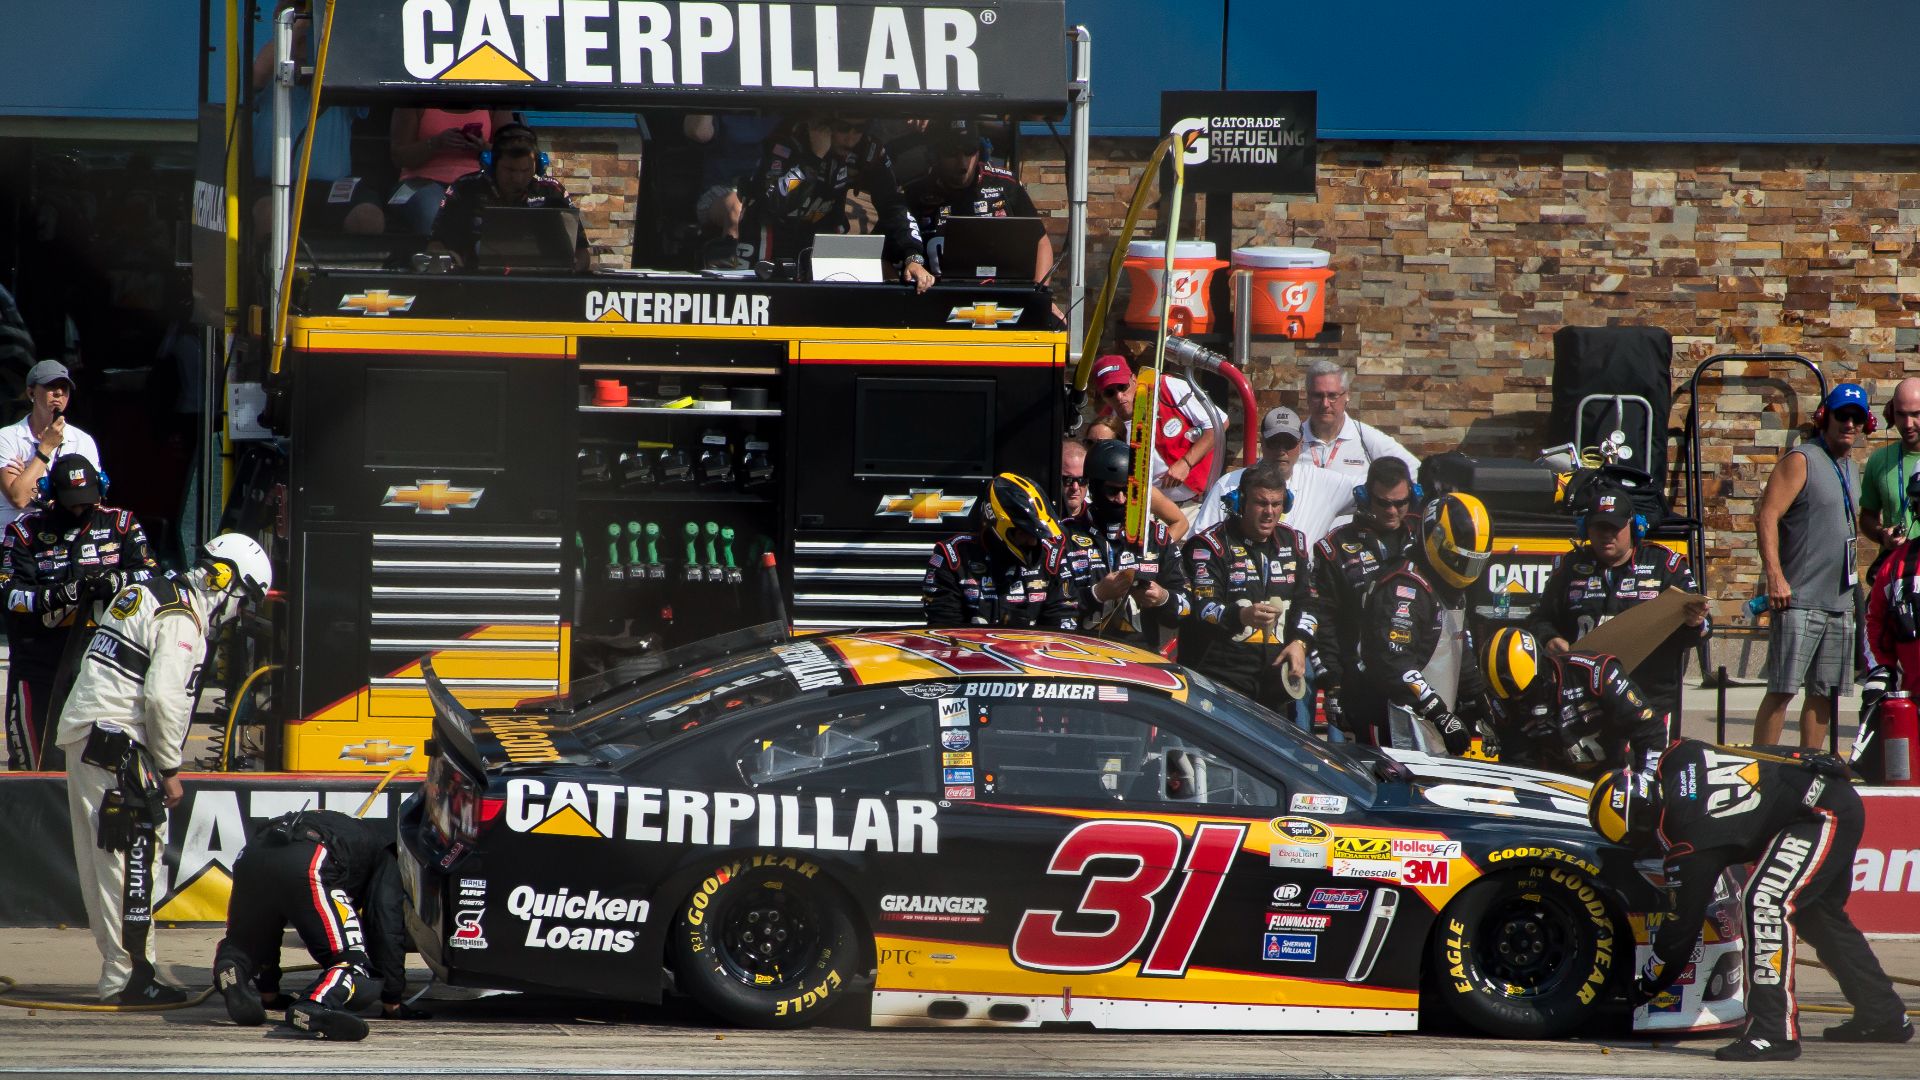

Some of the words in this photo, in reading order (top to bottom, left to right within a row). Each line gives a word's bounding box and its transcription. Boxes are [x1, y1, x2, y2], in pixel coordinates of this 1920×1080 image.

[402, 0, 980, 91] CATERPILLAR
[1211, 117, 1280, 128] GATORADE
[1211, 130, 1305, 146] REFUELING
[1211, 147, 1278, 164] STATION
[1286, 285, 1304, 305] G
[585, 291, 770, 326] CATERPILLAR
[69, 469, 85, 480] CAT
[1600, 496, 1616, 506] CAT
[985, 502, 996, 519] CAT
[1522, 633, 1534, 651] CAT
[965, 682, 1029, 698] BUDDY
[1032, 683, 1096, 700] BAKER
[942, 700, 966, 716] WIX
[1703, 749, 1762, 818] CAT
[1612, 790, 1624, 809] CAT
[506, 779, 938, 854] CATERPILLAR
[1291, 828, 1312, 836] Sprint
[1393, 840, 1434, 857] Holley
[129, 835, 148, 900] Sprint
[1488, 847, 1600, 876] GOODYEAR
[1350, 867, 1397, 878] freescale
[1403, 859, 1448, 885] 3M
[461, 879, 486, 888] MAHLE
[1277, 886, 1296, 899] IR
[507, 885, 650, 923] Quicken
[880, 894, 988, 914] GRAINGER
[1012, 819, 1250, 977] 31
[1315, 892, 1363, 903] Duralast
[124, 914, 151, 922] SERIES
[1753, 834, 1813, 986] CATERPILLAR
[1269, 914, 1327, 931] FLOWMASTER
[524, 918, 632, 953] Loans
[1282, 940, 1312, 948] SHERWIN
[880, 949, 917, 965] PTC
[1446, 918, 1475, 994] EAGLE
[774, 969, 843, 1017] EAGLE
